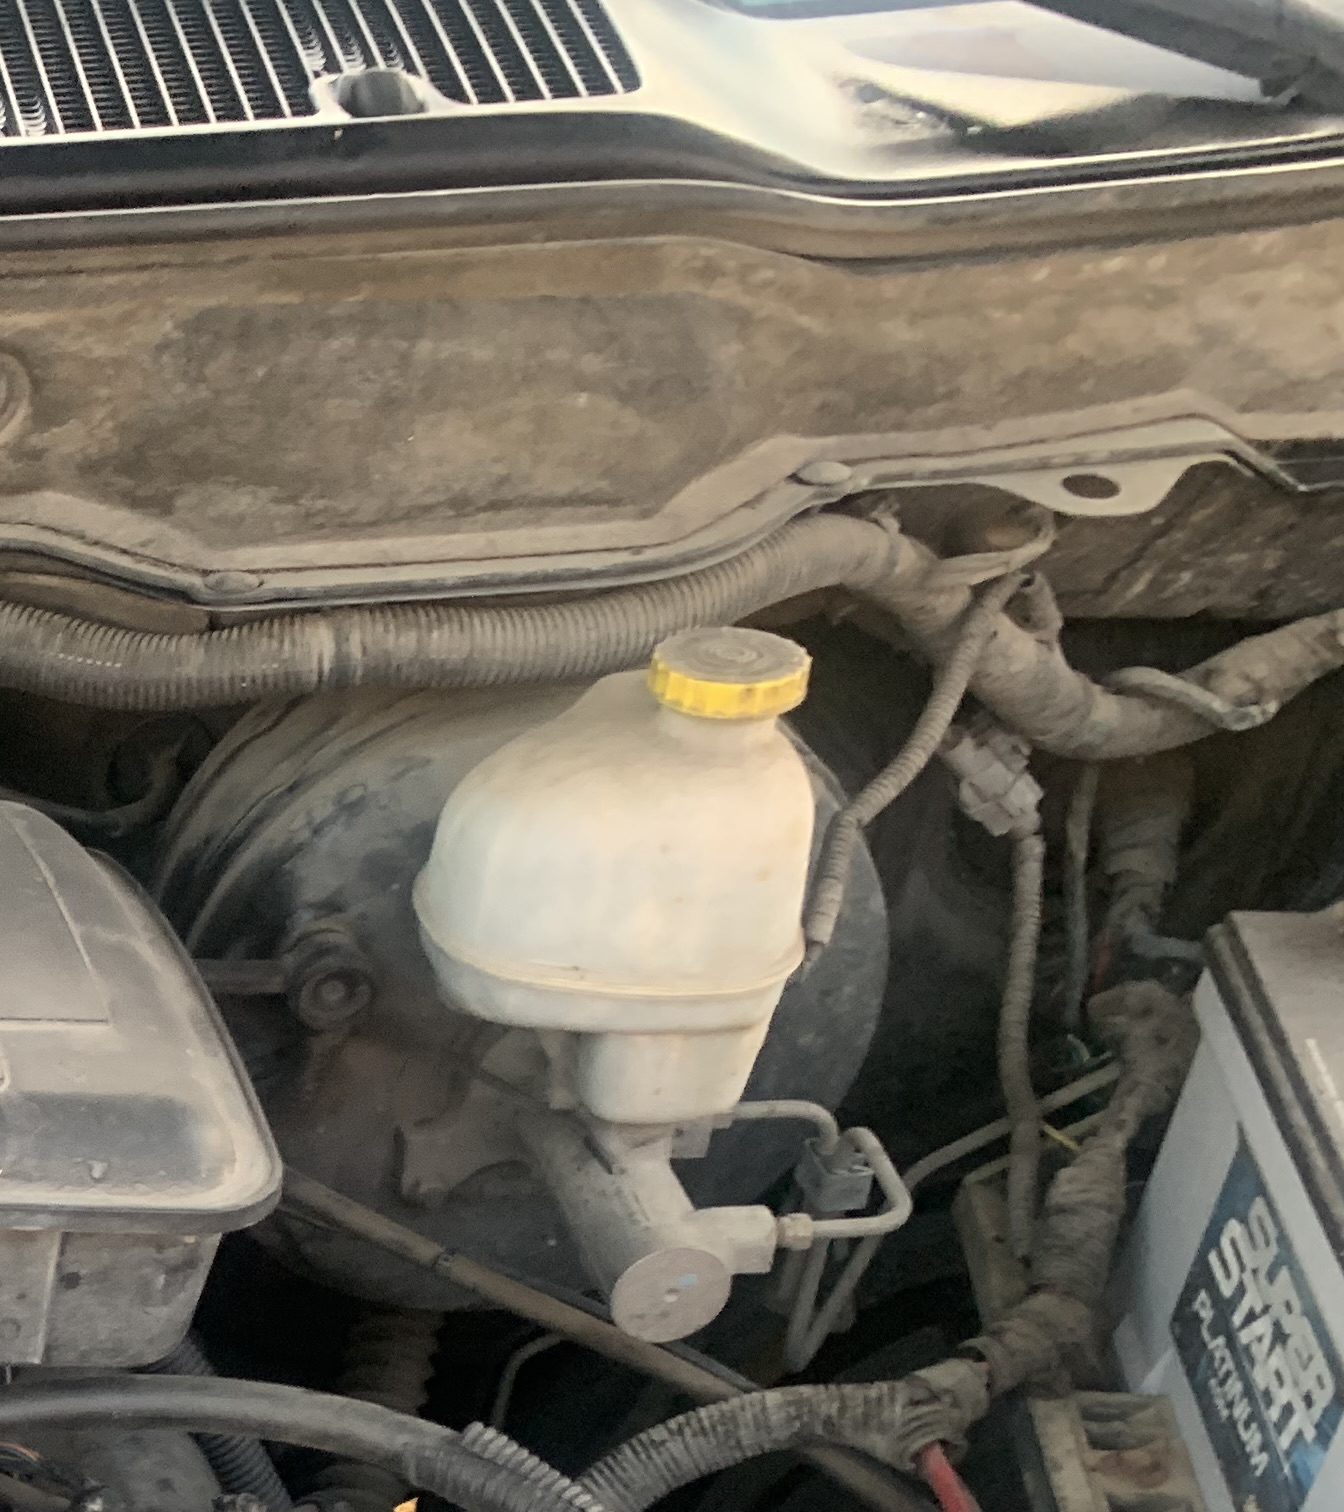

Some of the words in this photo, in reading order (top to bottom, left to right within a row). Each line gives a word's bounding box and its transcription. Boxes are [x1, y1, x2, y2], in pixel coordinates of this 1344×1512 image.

[1192, 1289, 1269, 1477] PLATINUM
[1208, 1218, 1316, 1451] START
[1248, 1197, 1335, 1425] SUPER
